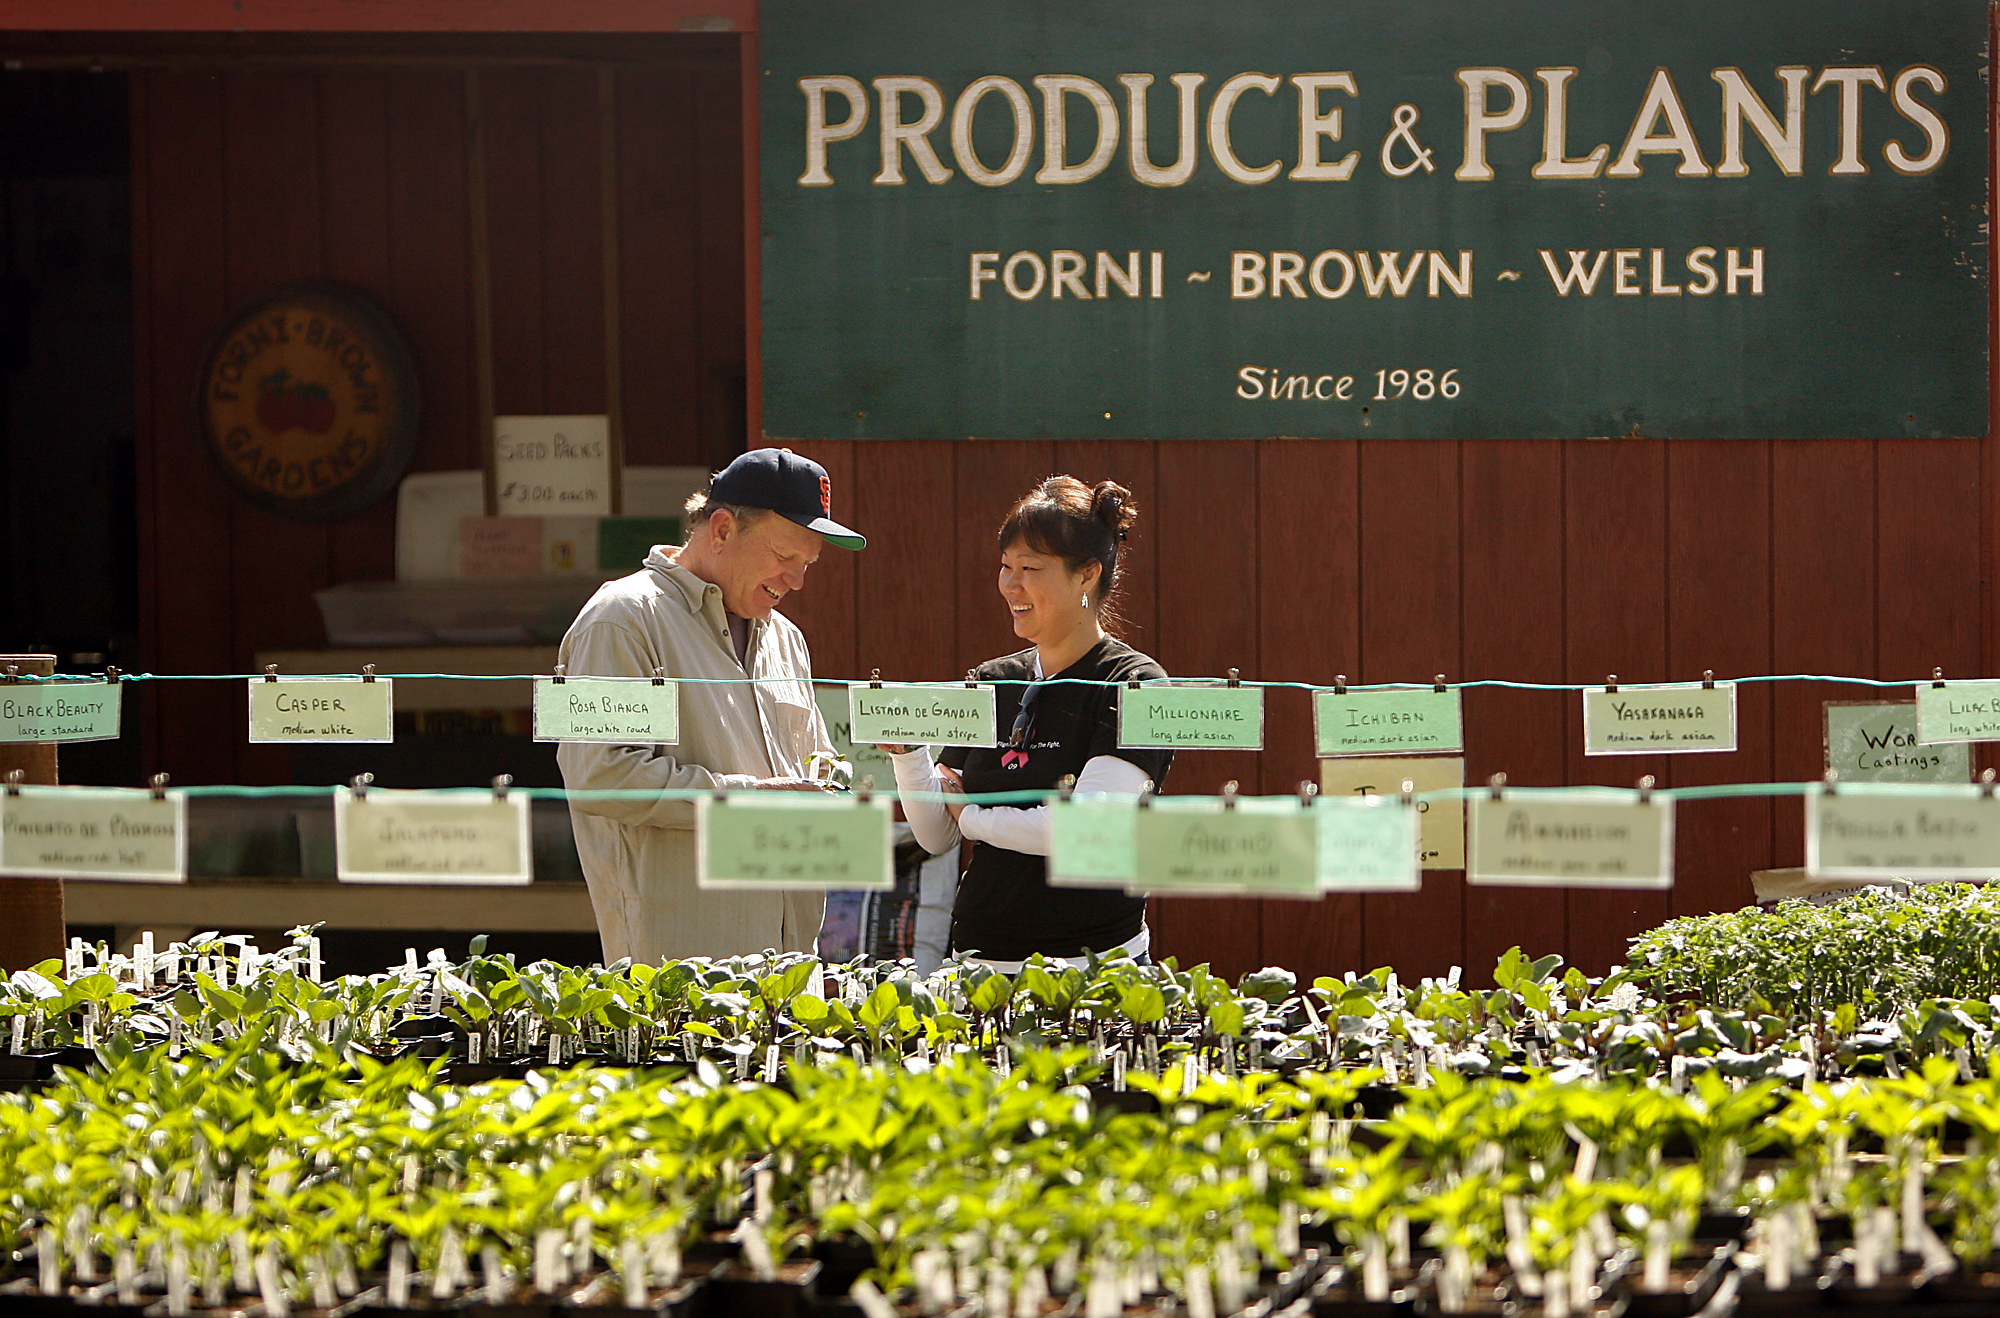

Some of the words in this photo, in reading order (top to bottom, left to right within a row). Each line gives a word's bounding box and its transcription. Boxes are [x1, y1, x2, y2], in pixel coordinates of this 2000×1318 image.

[796, 71, 1360, 188] PRODUCE
[1379, 103, 1437, 178] &
[1455, 64, 1951, 181] PLANTS
[969, 249, 1164, 301] FORNI
[1231, 248, 1474, 300] BROWN
[1538, 246, 1766, 298] WELSH
[1236, 365, 1354, 401] Since
[1374, 368, 1461, 401] 1986
[496, 434, 547, 460] SEED
[224, 426, 368, 492] GARDENS
[276, 693, 346, 713] CASPER
[569, 694, 597, 716] ROSA
[602, 696, 649, 714] BIANCA
[860, 699, 910, 717] LISTADA
[915, 707, 928, 718] DE
[932, 702, 980, 720] GANDIA
[1949, 701, 1988, 714] LILAC
[1149, 705, 1245, 721] MILLIONAIRE
[1346, 709, 1425, 728] ICHIBAN
[18, 724, 46, 739] large
[52, 723, 94, 736] standard
[281, 721, 316, 736] medium
[321, 723, 354, 735] white
[571, 720, 594, 736] large
[597, 723, 621, 734] white
[626, 724, 652, 735] round
[881, 726, 915, 738] medium
[920, 727, 939, 738] oval
[947, 728, 980, 741] stripe
[1151, 728, 1173, 743] long
[1176, 730, 1200, 740] dark
[1205, 731, 1235, 741] asian
[1606, 731, 1644, 742] medium
[1649, 730, 1674, 741] dark
[1681, 730, 1715, 741] asian
[1950, 722, 1970, 735] long
[1340, 735, 1376, 745] medium
[1380, 735, 1404, 744] dark
[1407, 734, 1439, 743] asian
[1858, 752, 1940, 770] Castings
